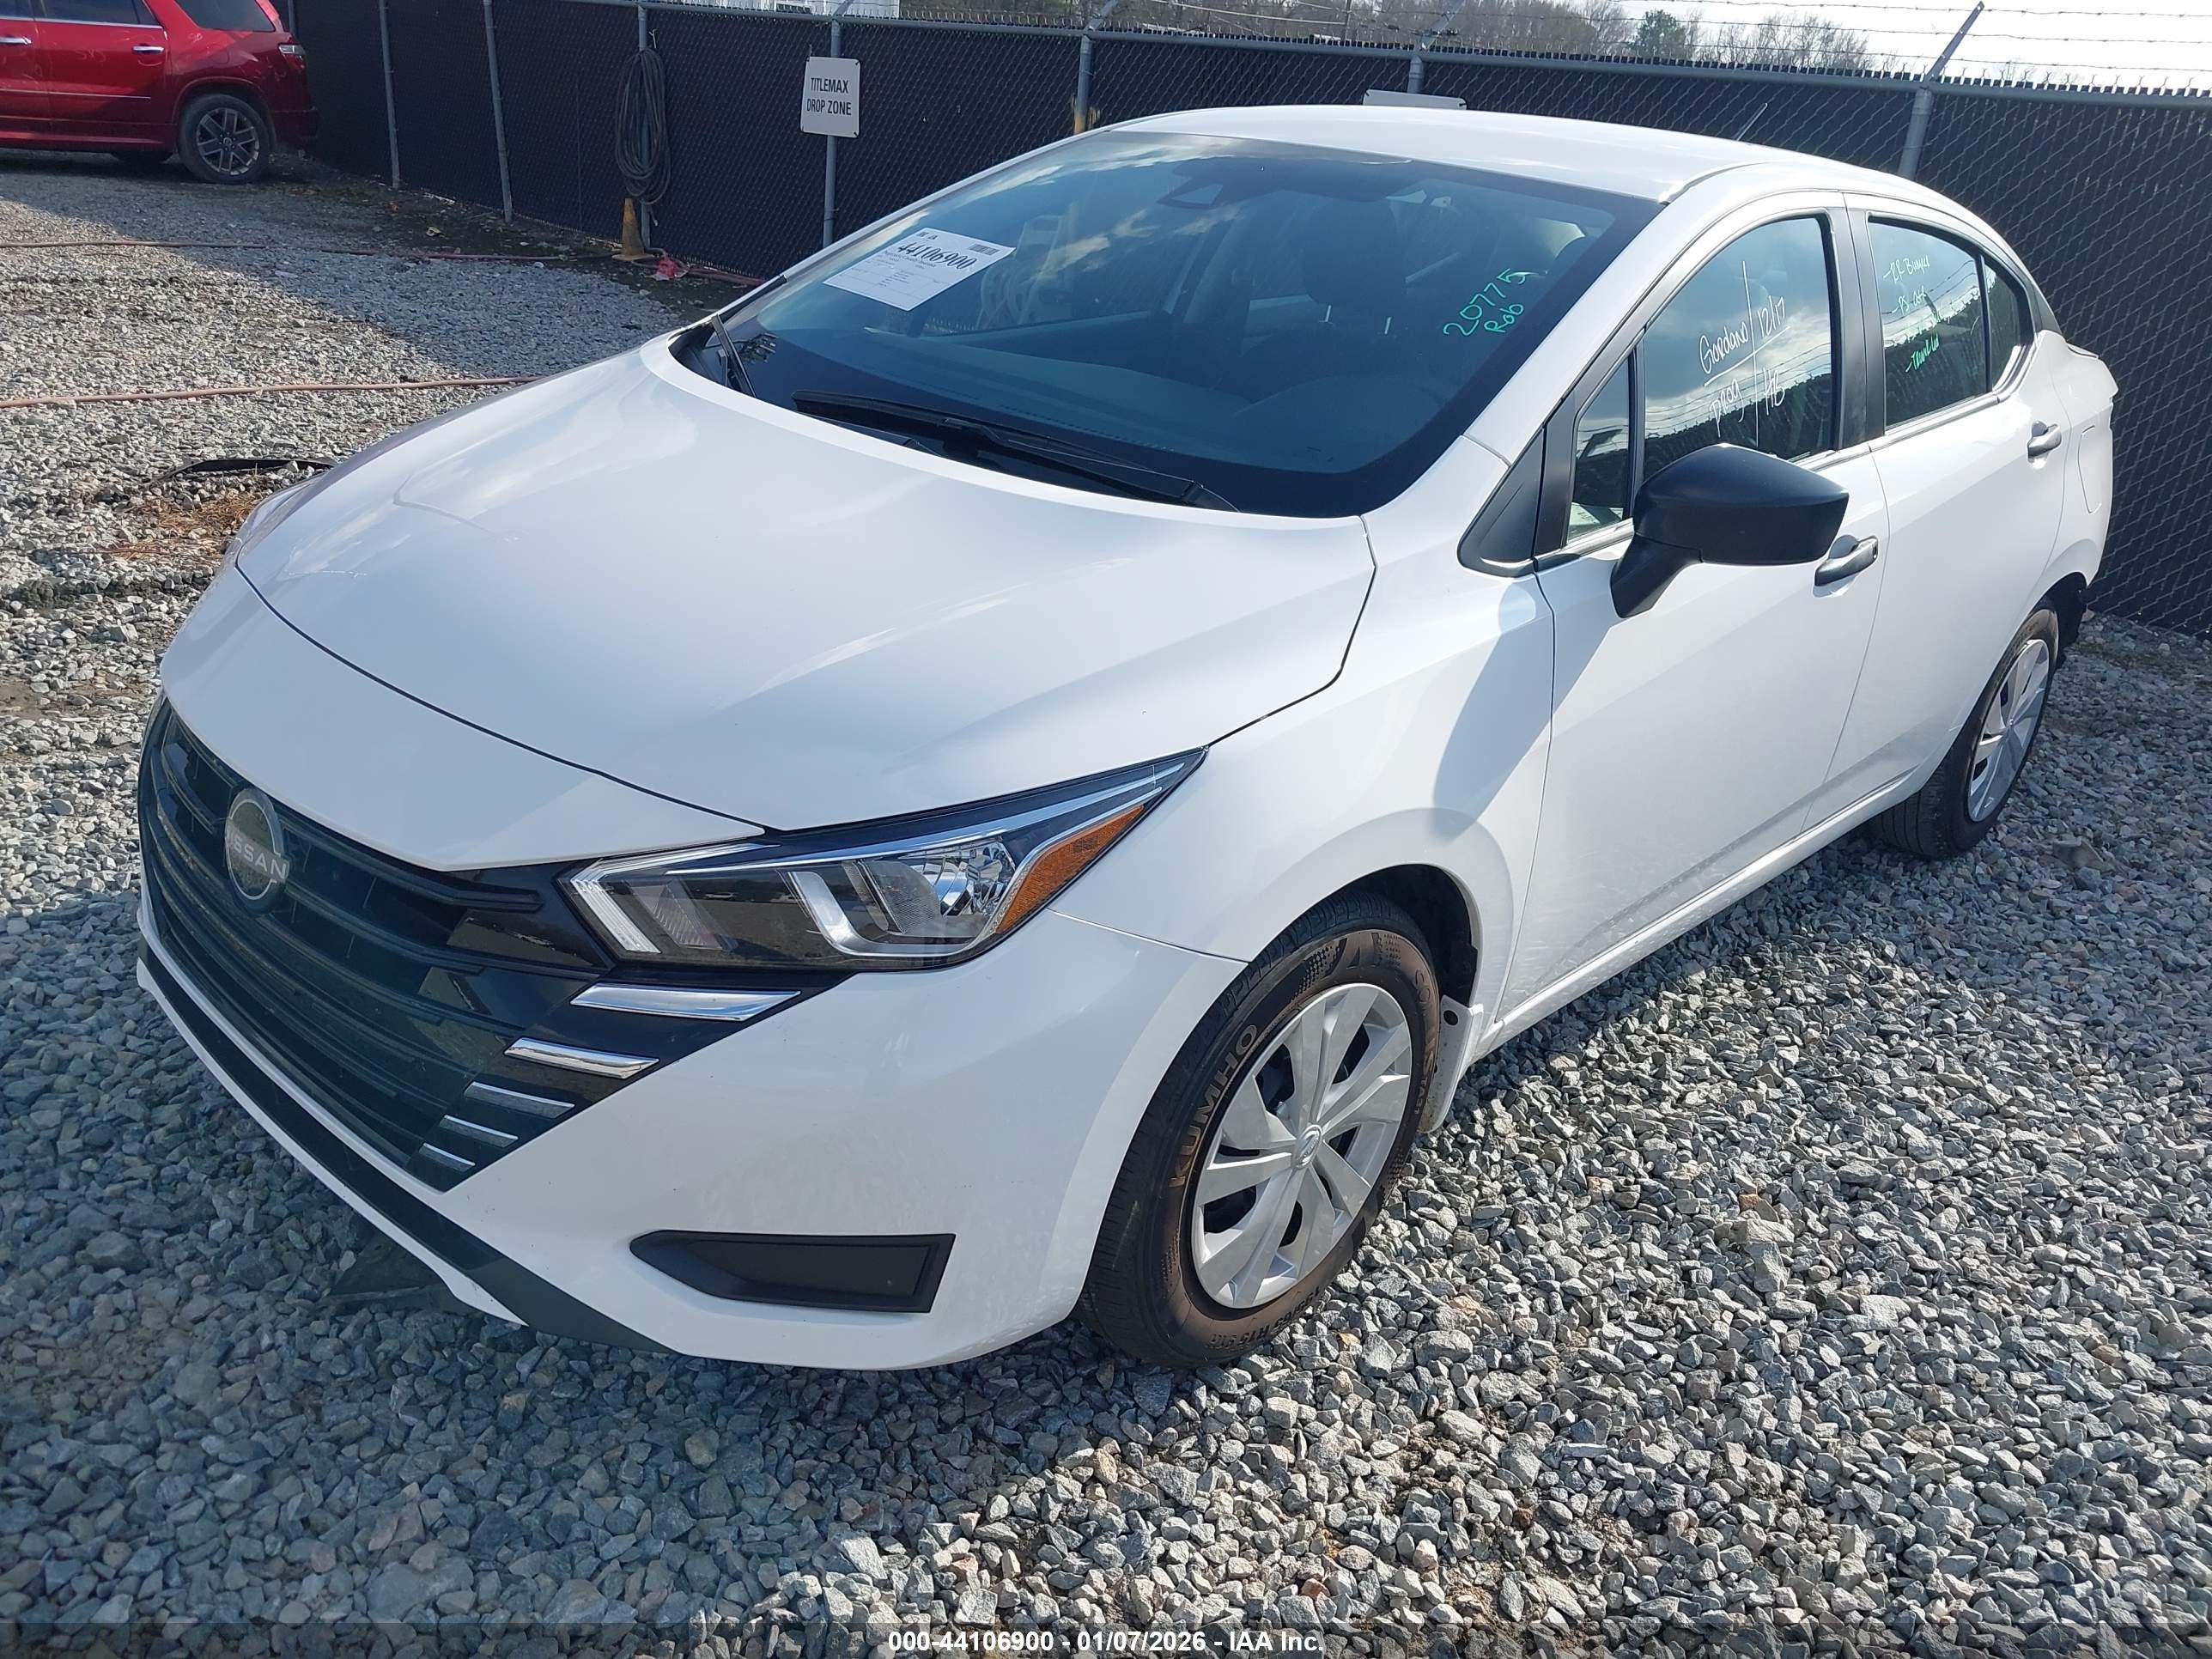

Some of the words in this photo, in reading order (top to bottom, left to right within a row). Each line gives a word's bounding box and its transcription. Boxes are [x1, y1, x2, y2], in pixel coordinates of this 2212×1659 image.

[811, 77, 849, 94] TITLEMAX
[806, 99, 825, 112] DROP
[827, 100, 852, 116] ZONE
[897, 242, 977, 270] 44106900
[1443, 268, 1526, 336] 20775
[1484, 304, 1524, 333] Rob
[226, 830, 287, 880] SSAN
[1169, 1024, 1258, 1188] KUMHO
